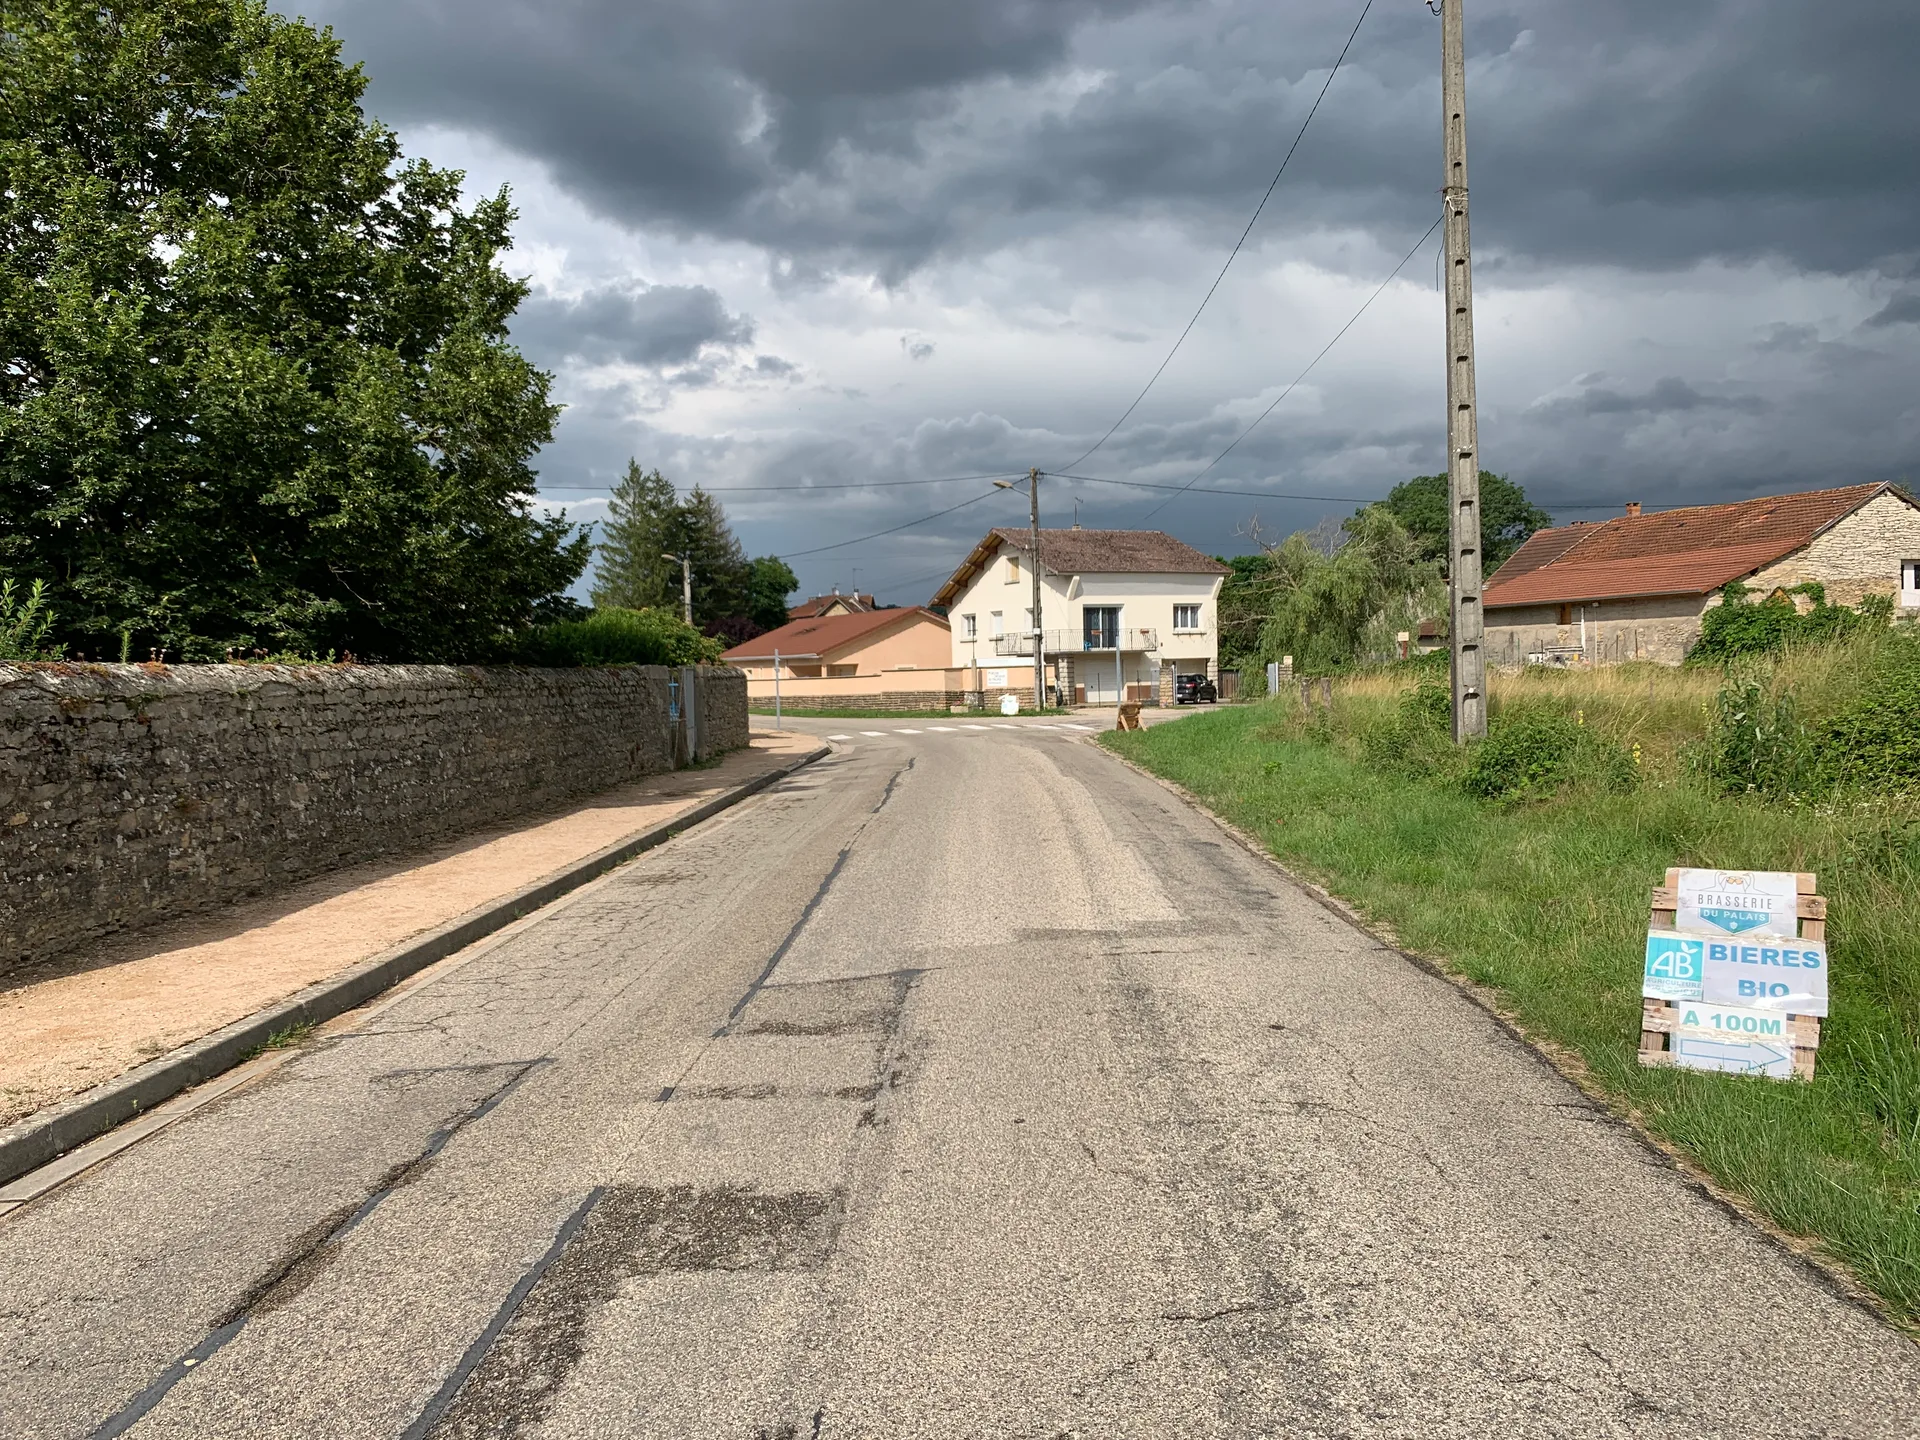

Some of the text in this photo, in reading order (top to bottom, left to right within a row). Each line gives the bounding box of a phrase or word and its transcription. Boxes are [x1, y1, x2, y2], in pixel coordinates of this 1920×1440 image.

[1697, 893, 1773, 910] BRASSERIE
[1703, 909, 1766, 921] DU PALAIS
[1650, 951, 1694, 978] AB
[1709, 943, 1821, 969] BIERES
[1738, 979, 1790, 998] BIO
[1682, 1010, 1781, 1035] A 100M
